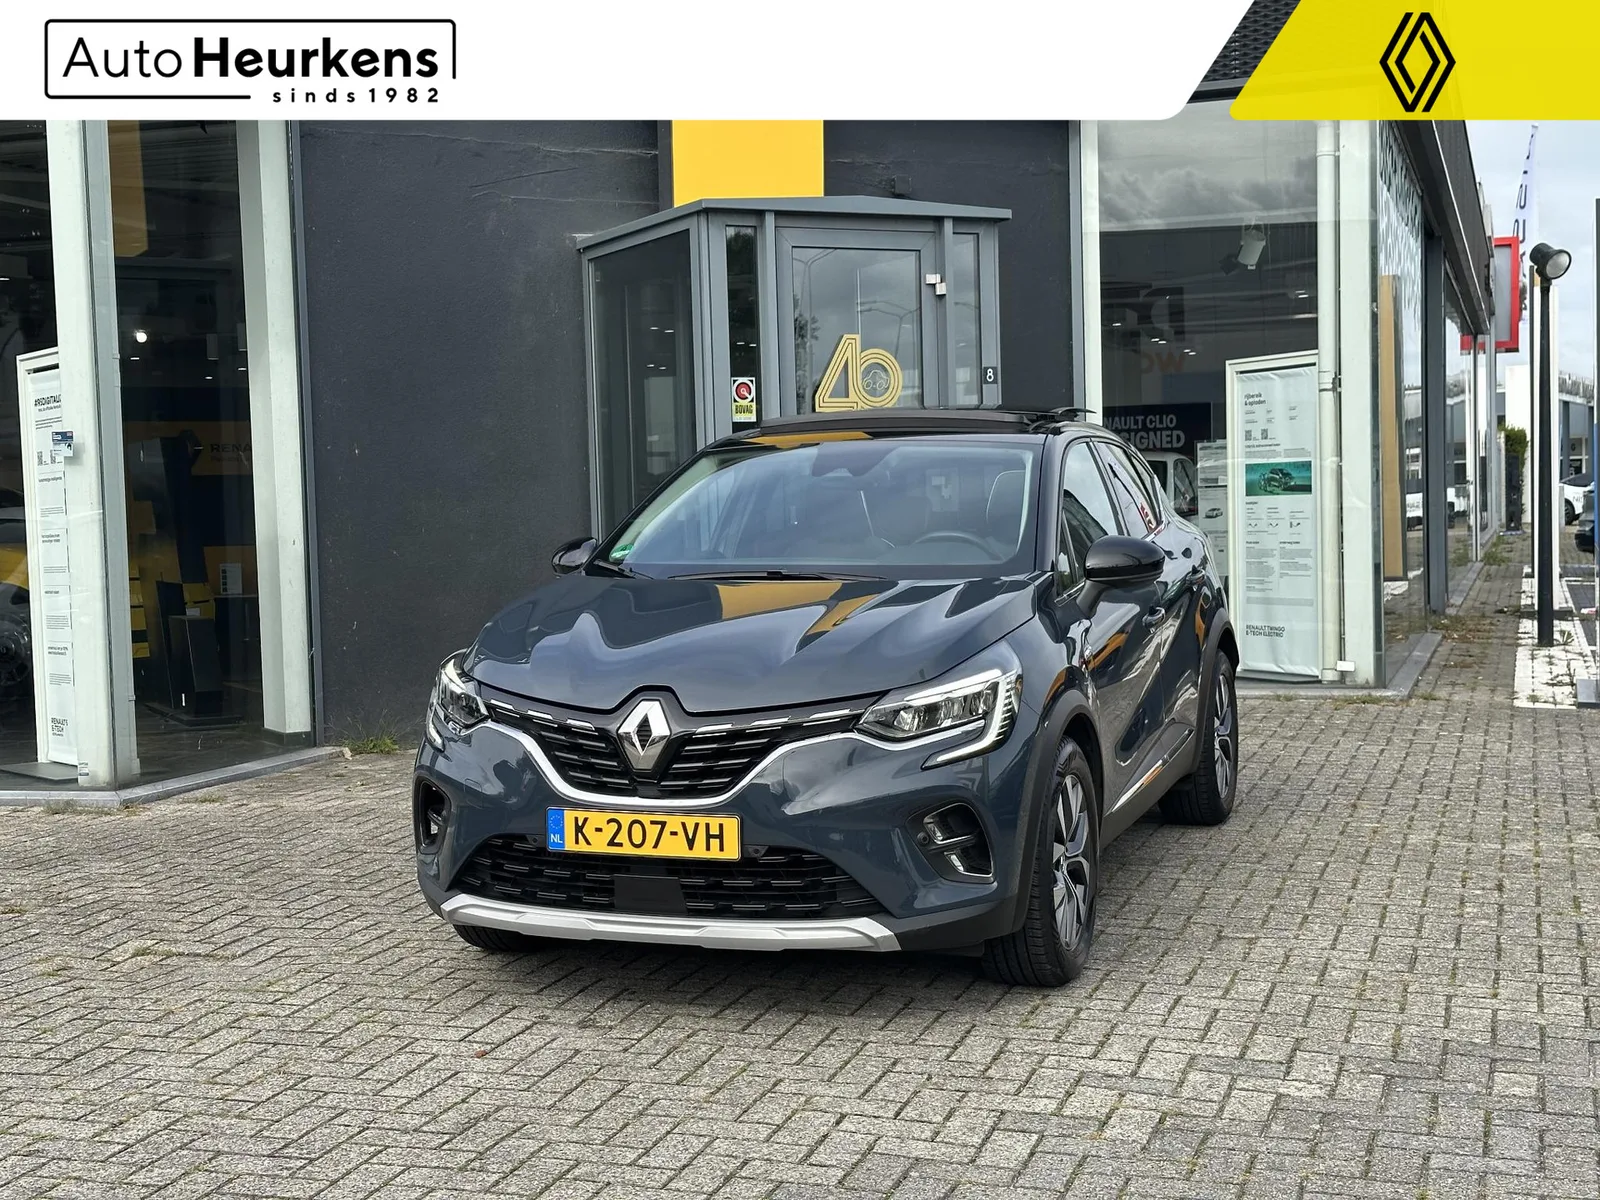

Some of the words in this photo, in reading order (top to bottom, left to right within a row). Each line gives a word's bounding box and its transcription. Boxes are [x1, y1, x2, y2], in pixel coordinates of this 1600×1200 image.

[986, 368, 995, 382] 8
[735, 404, 754, 415] BOVAG
[1146, 413, 1178, 429] CLIO
[551, 833, 563, 844] NL
[573, 816, 725, 852] K-207-VH
